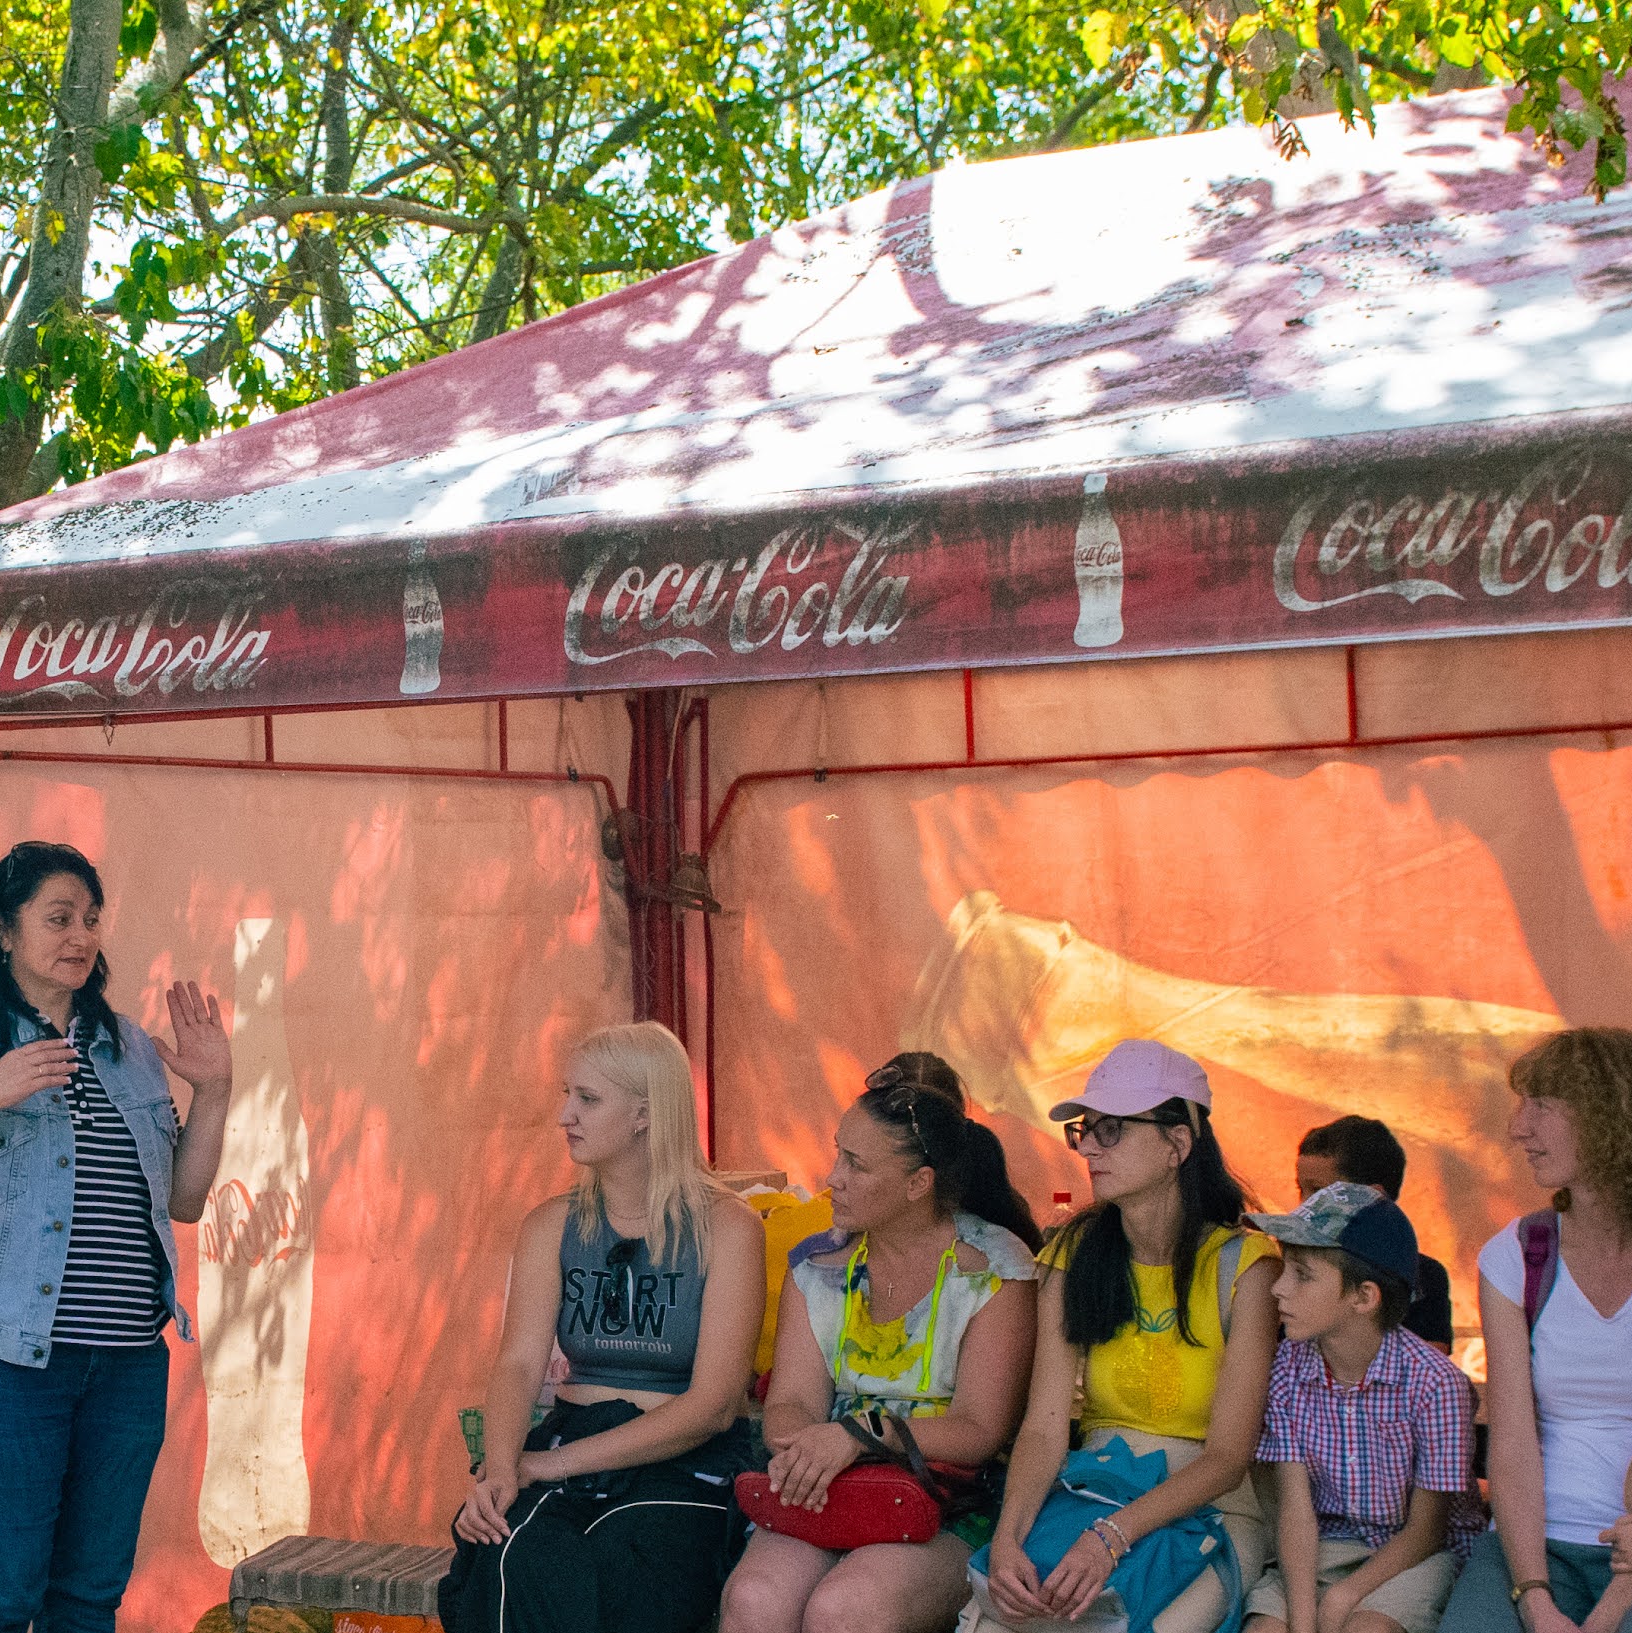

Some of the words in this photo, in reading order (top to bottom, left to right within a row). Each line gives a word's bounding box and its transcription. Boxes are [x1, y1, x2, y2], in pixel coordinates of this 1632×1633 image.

[564, 514, 920, 665] Coca-Cola
[566, 1267, 685, 1308] STRT
[567, 1300, 667, 1339] NOW
[595, 1337, 672, 1354] tomorrow
